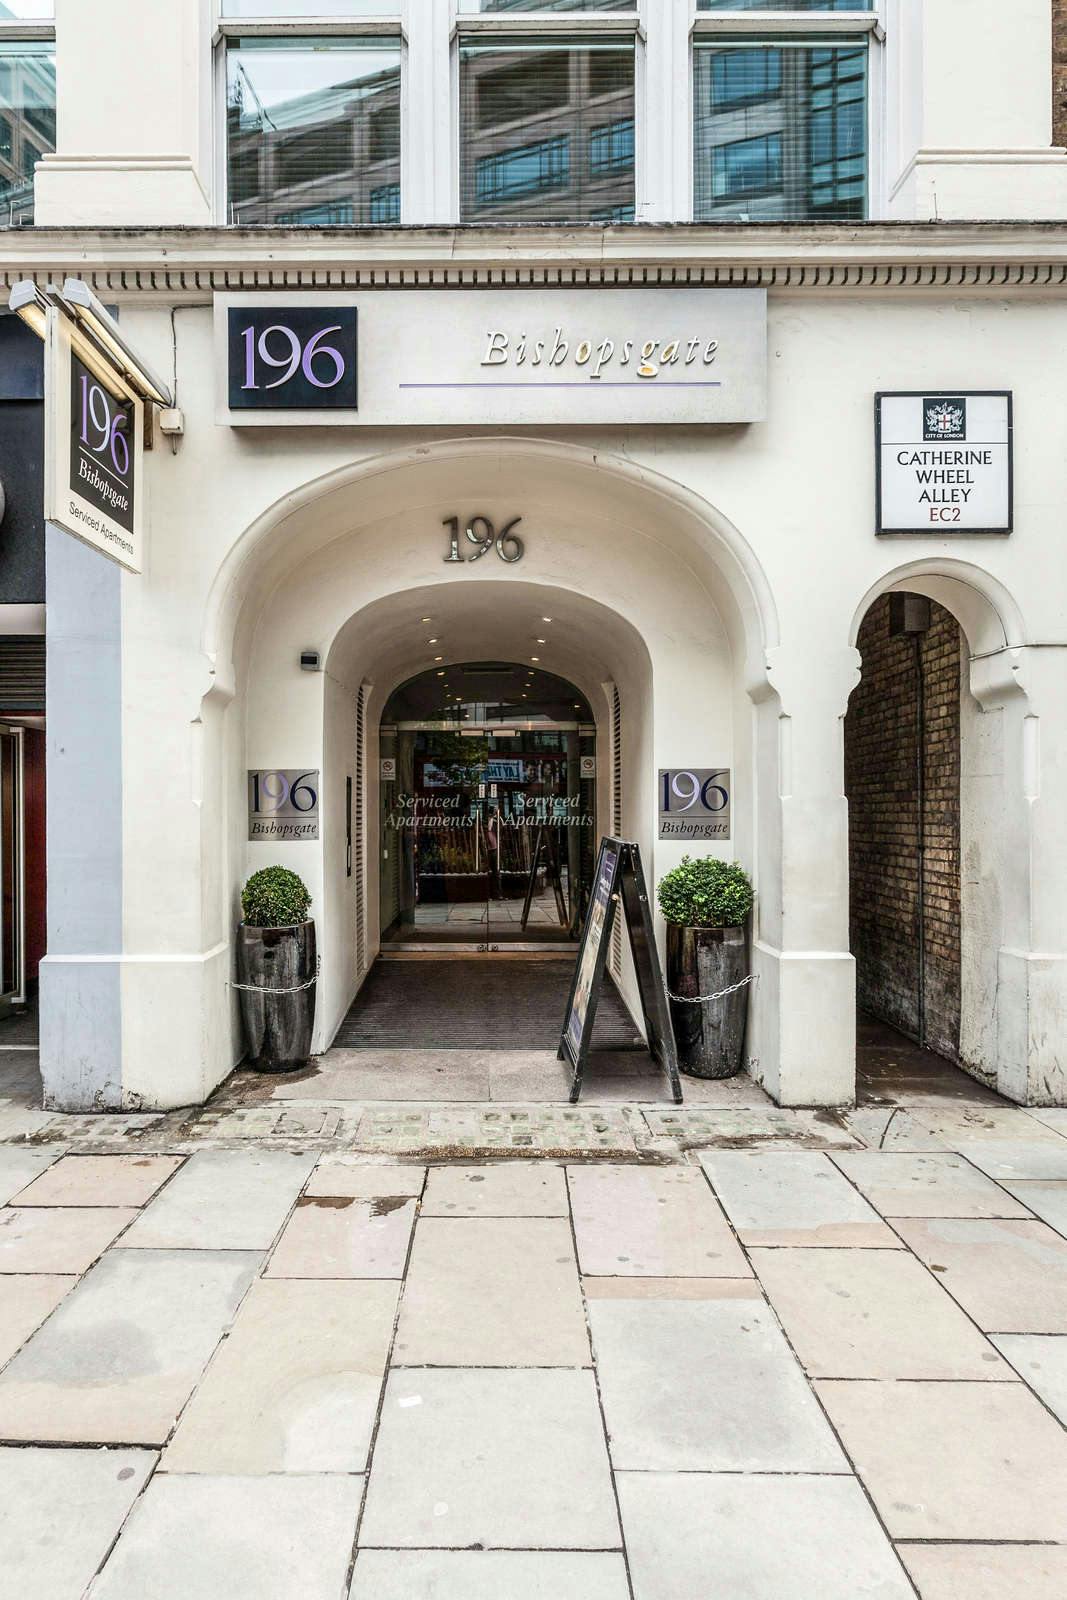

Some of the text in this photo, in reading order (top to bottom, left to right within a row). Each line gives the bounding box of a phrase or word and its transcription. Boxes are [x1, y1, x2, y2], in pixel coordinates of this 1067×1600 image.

[240, 325, 345, 389] 196
[480, 327, 720, 378] Bishopsgate
[79, 375, 130, 475] 196
[896, 450, 993, 465] CATHERINE
[78, 457, 129, 511] Bishopsgate
[915, 469, 975, 484] WHEEL
[918, 488, 972, 503] ALLEY
[929, 507, 961, 522] EC2
[69, 501, 134, 555] Serviced Apartments
[442, 515, 525, 563] 196
[250, 771, 317, 813] 196
[660, 771, 729, 812] 196
[396, 793, 461, 808] Serviced
[517, 793, 581, 808] Serviced
[251, 821, 317, 838] Bishopsgate
[384, 814, 474, 830] Apartments
[505, 813, 594, 830] Apartments
[661, 820, 729, 838] Bishopsgate
